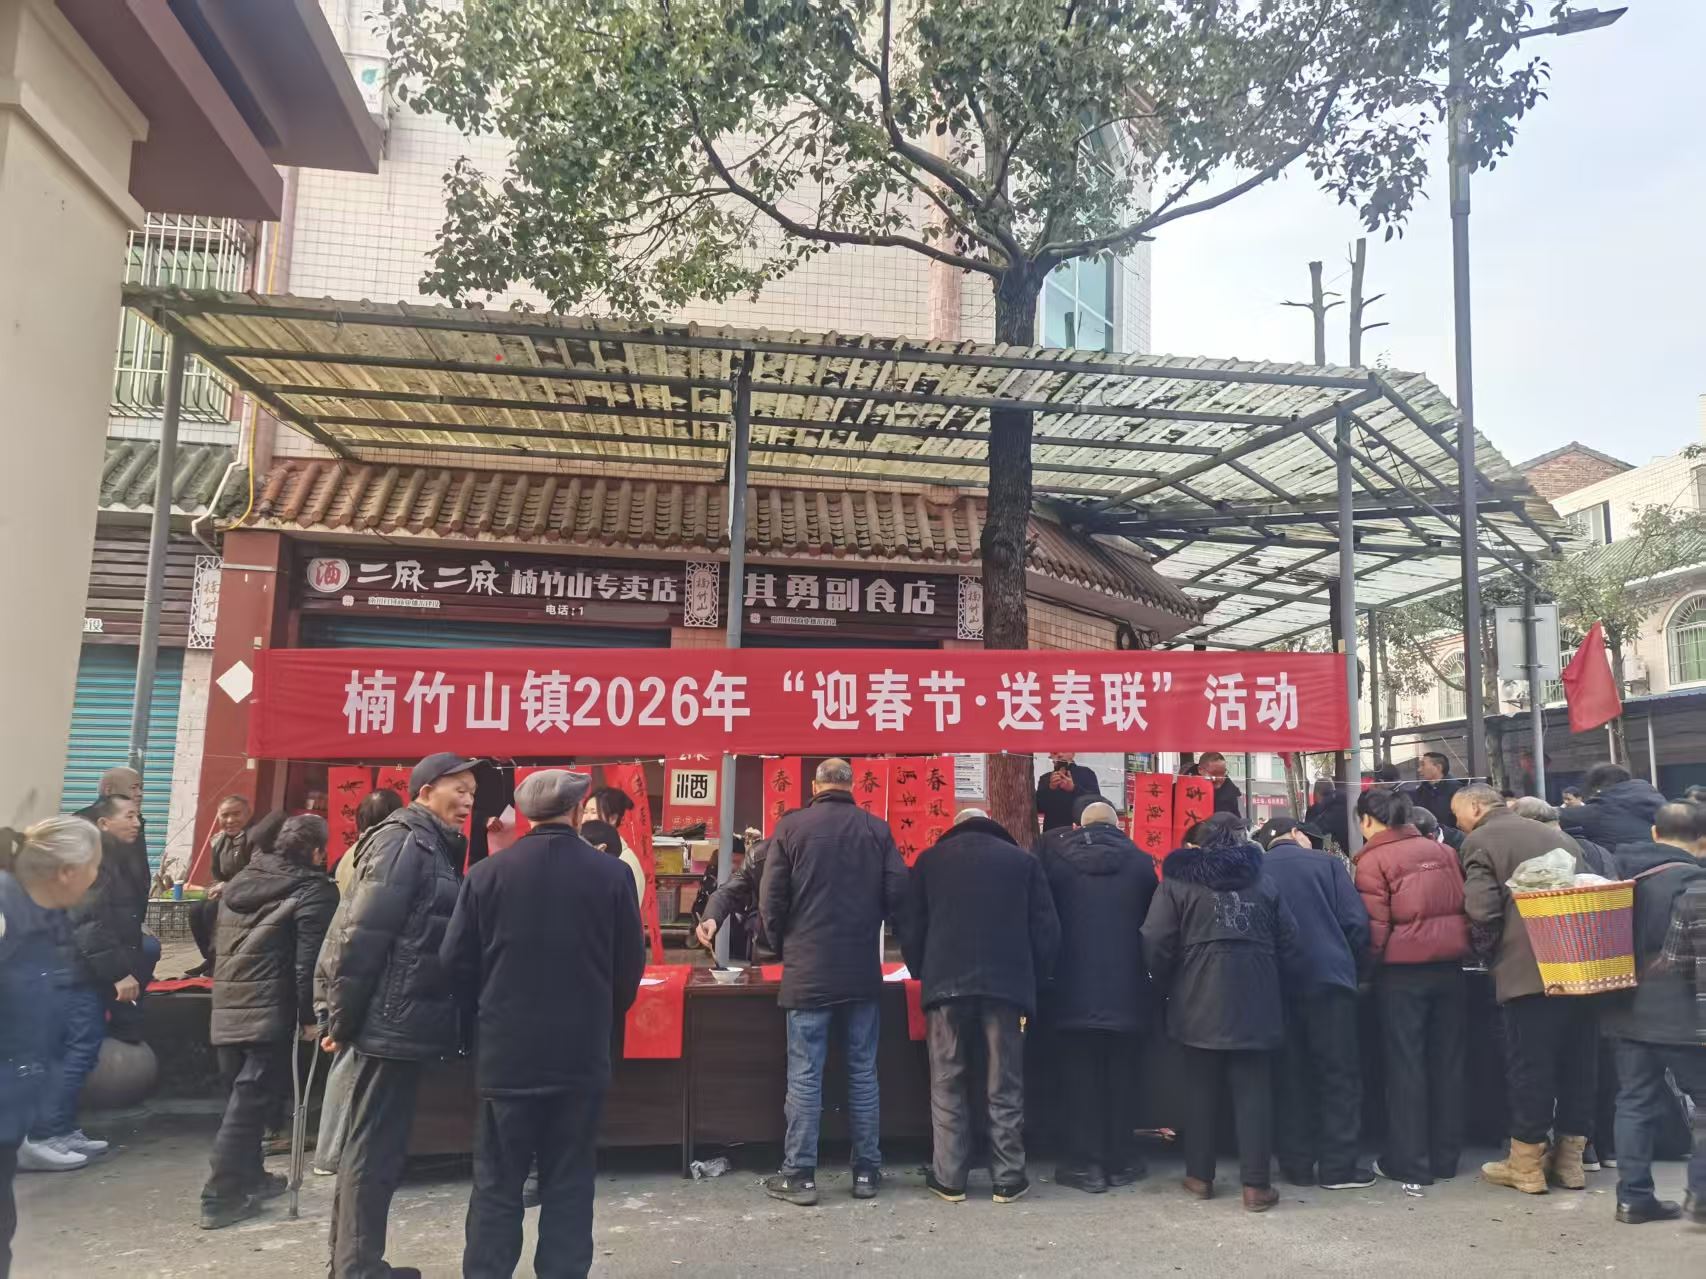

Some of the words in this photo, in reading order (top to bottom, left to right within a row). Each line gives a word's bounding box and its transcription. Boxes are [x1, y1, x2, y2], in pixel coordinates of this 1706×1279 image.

[315, 560, 342, 587] 酒
[357, 559, 504, 597] 二麻二麻
[511, 569, 678, 602] 楠竹山专卖店
[743, 572, 936, 615] 其勇副食店
[342, 669, 751, 735] 楠竹山镇2026年
[782, 668, 1172, 733] “迎春节·送春联”
[1203, 671, 1299, 732] 活动
